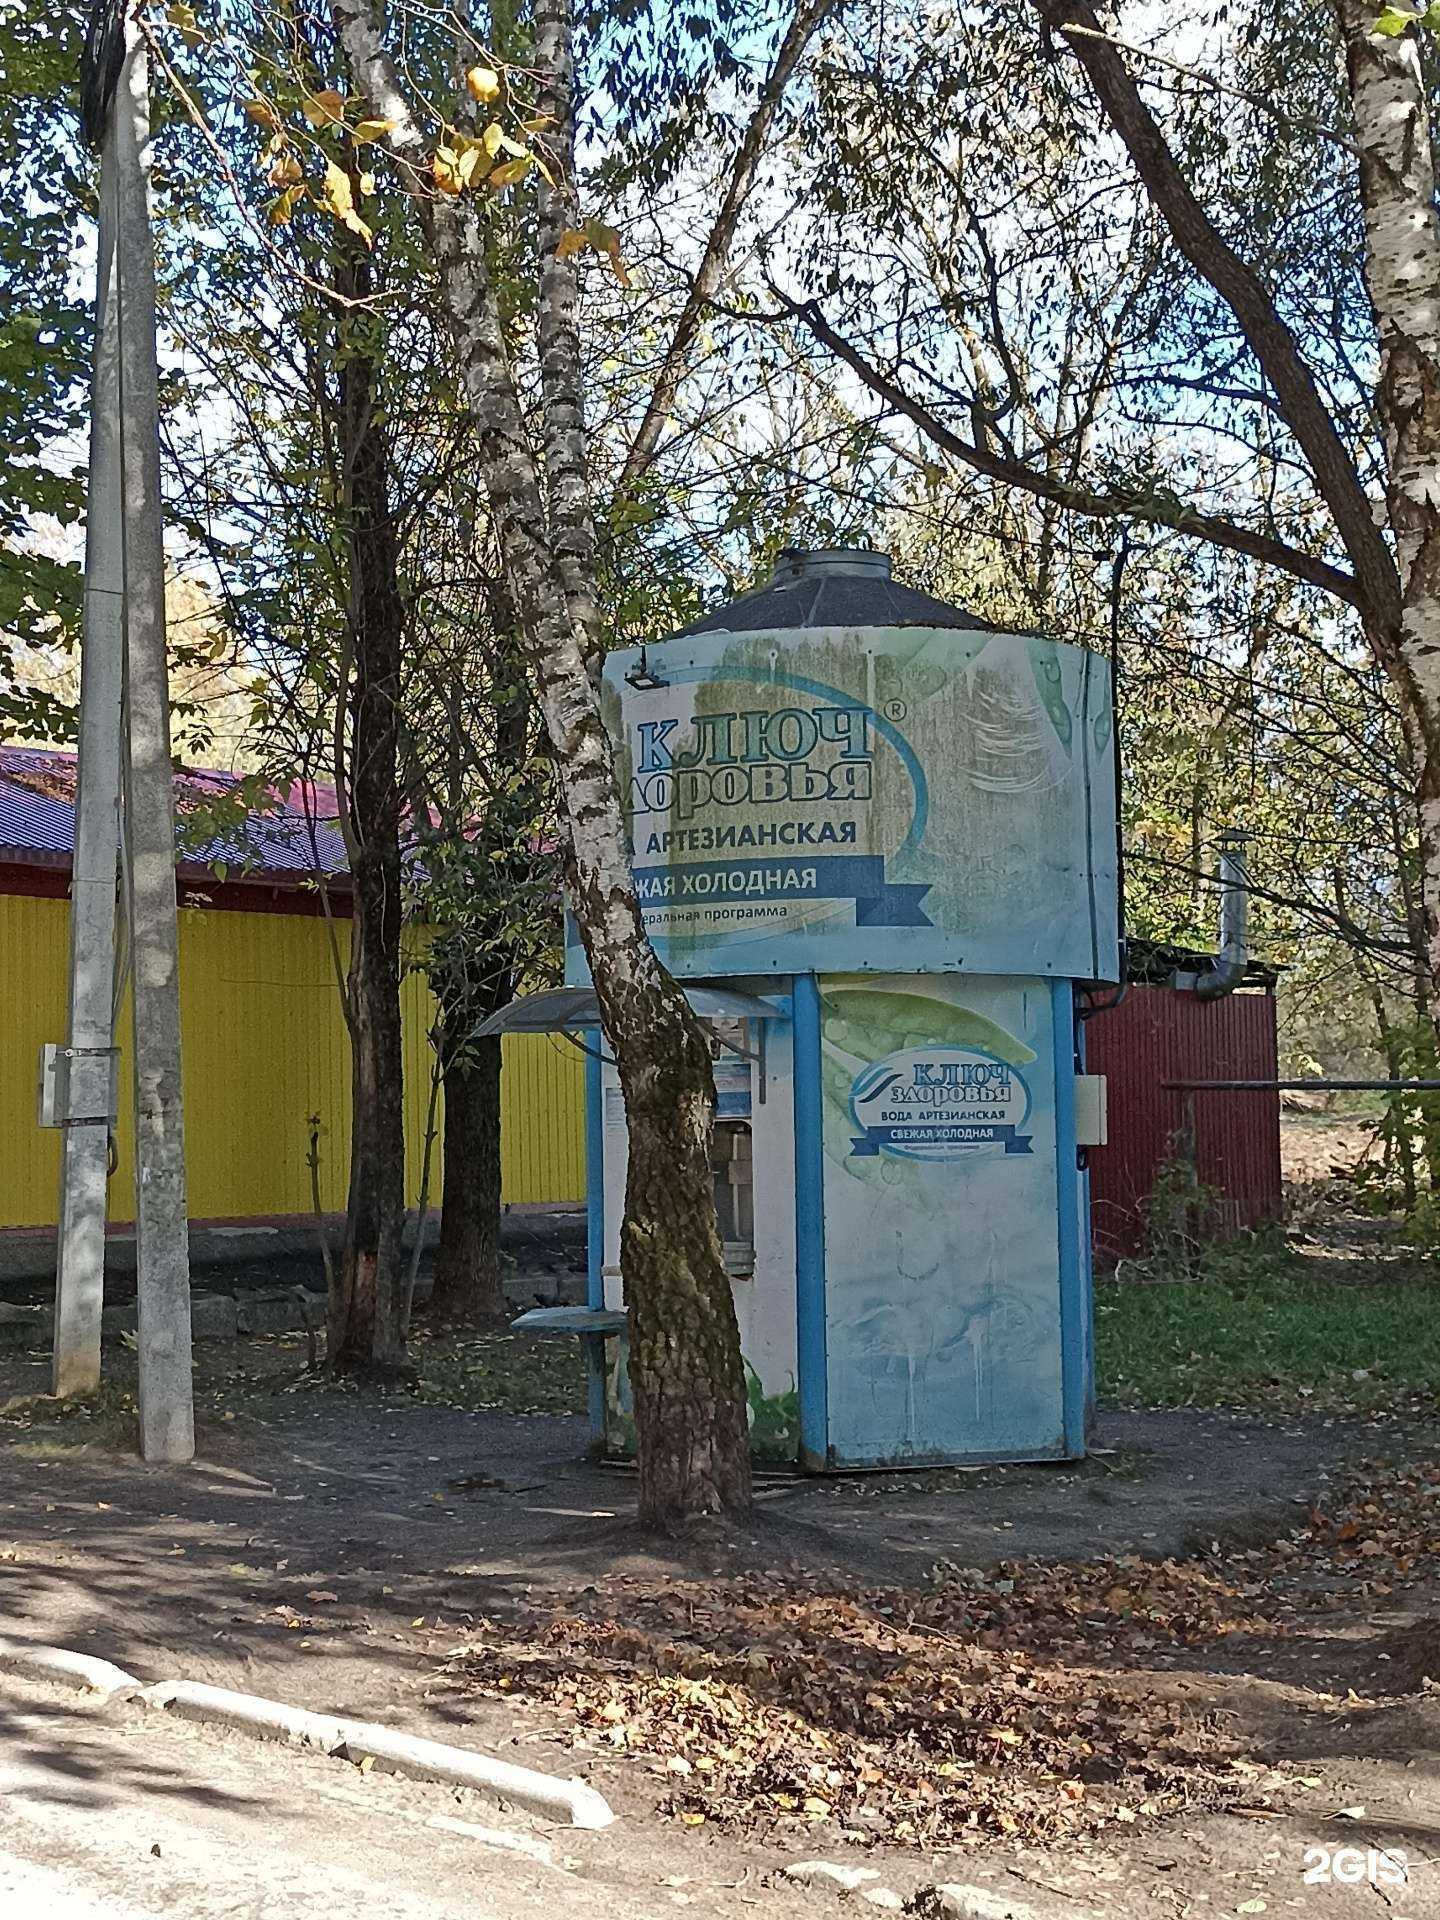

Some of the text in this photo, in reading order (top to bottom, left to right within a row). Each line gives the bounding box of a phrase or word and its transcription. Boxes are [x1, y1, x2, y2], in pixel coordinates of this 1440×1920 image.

[637, 707, 873, 773] КЛЮЧ
[618, 760, 872, 819] ДОРОВЬЯ
[646, 821, 856, 854] АРТЕЗИАНСКАЯ
[635, 868, 817, 899] ЖАЯ ХОЛОДНАЯ
[642, 905, 787, 926] еральная программа
[913, 1063, 1012, 1086] КЛЮЧ
[881, 1110, 1006, 1121] ВОДА АРТЕЗИАНСКАЯ
[890, 1127, 994, 1140] СВЕЖАЯ ХОЛОДНАЯ
